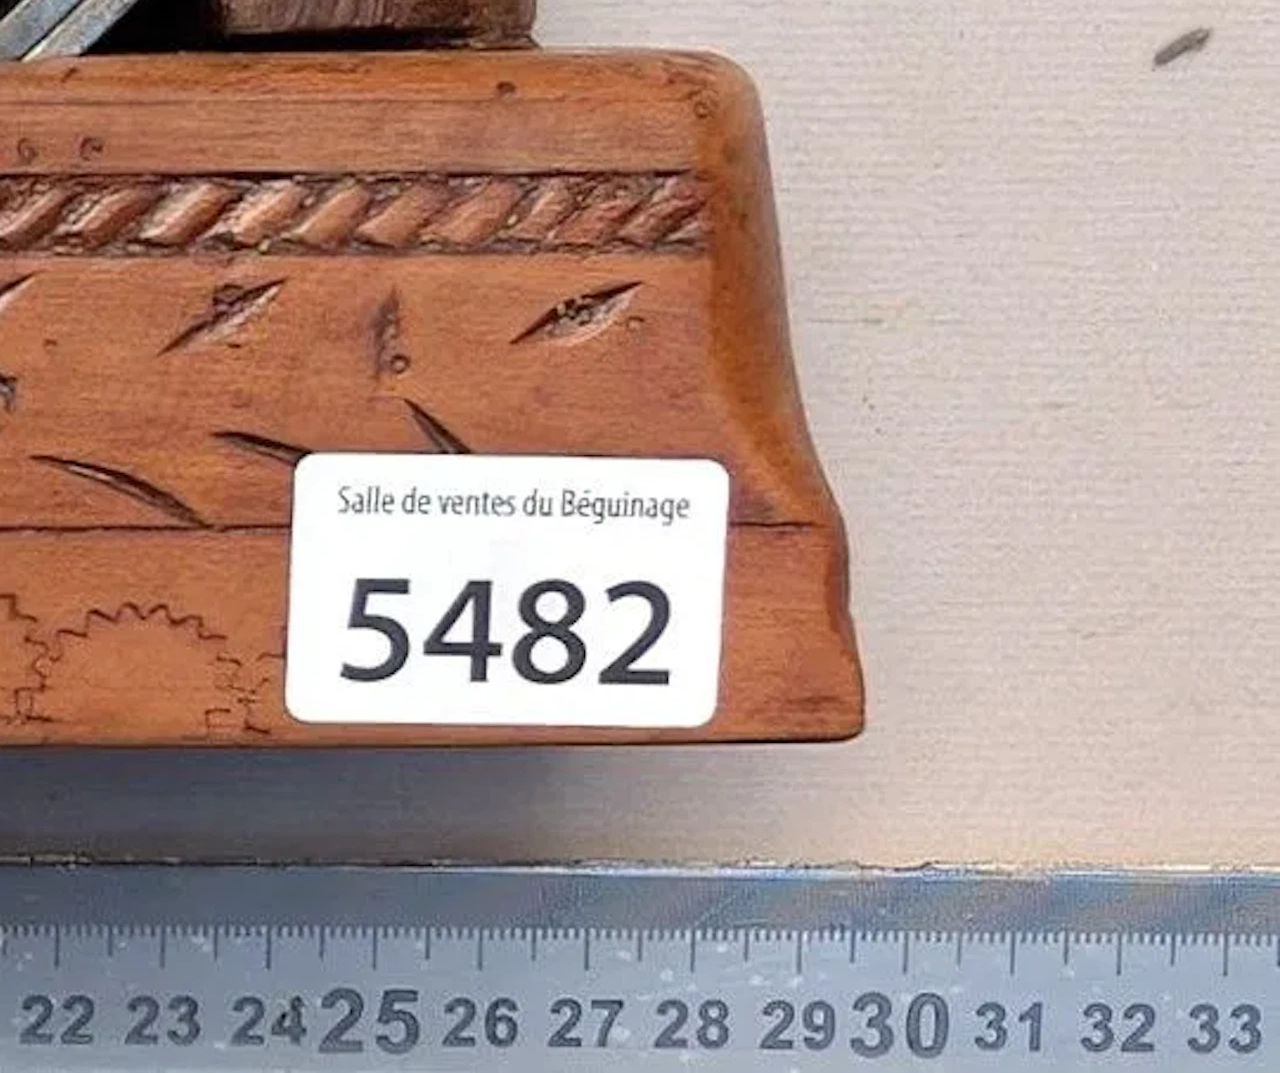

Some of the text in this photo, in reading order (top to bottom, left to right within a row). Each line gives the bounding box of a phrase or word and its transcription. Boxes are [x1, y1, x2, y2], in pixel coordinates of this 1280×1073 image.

[339, 485, 692, 526] Salle de ventes du Béguinage
[339, 577, 672, 686] 5482
[21, 994, 94, 1044] 22
[125, 995, 201, 1045] 23
[232, 996, 307, 1045] 24
[319, 988, 420, 1054] 25
[442, 998, 518, 1047] 26
[548, 998, 624, 1047] 27
[654, 999, 729, 1049] 28
[760, 1000, 835, 1050] 29
[850, 992, 949, 1058] 30
[975, 1002, 1043, 1052] 31
[1080, 1003, 1156, 1053] 32
[1187, 1004, 1261, 1054] 33
